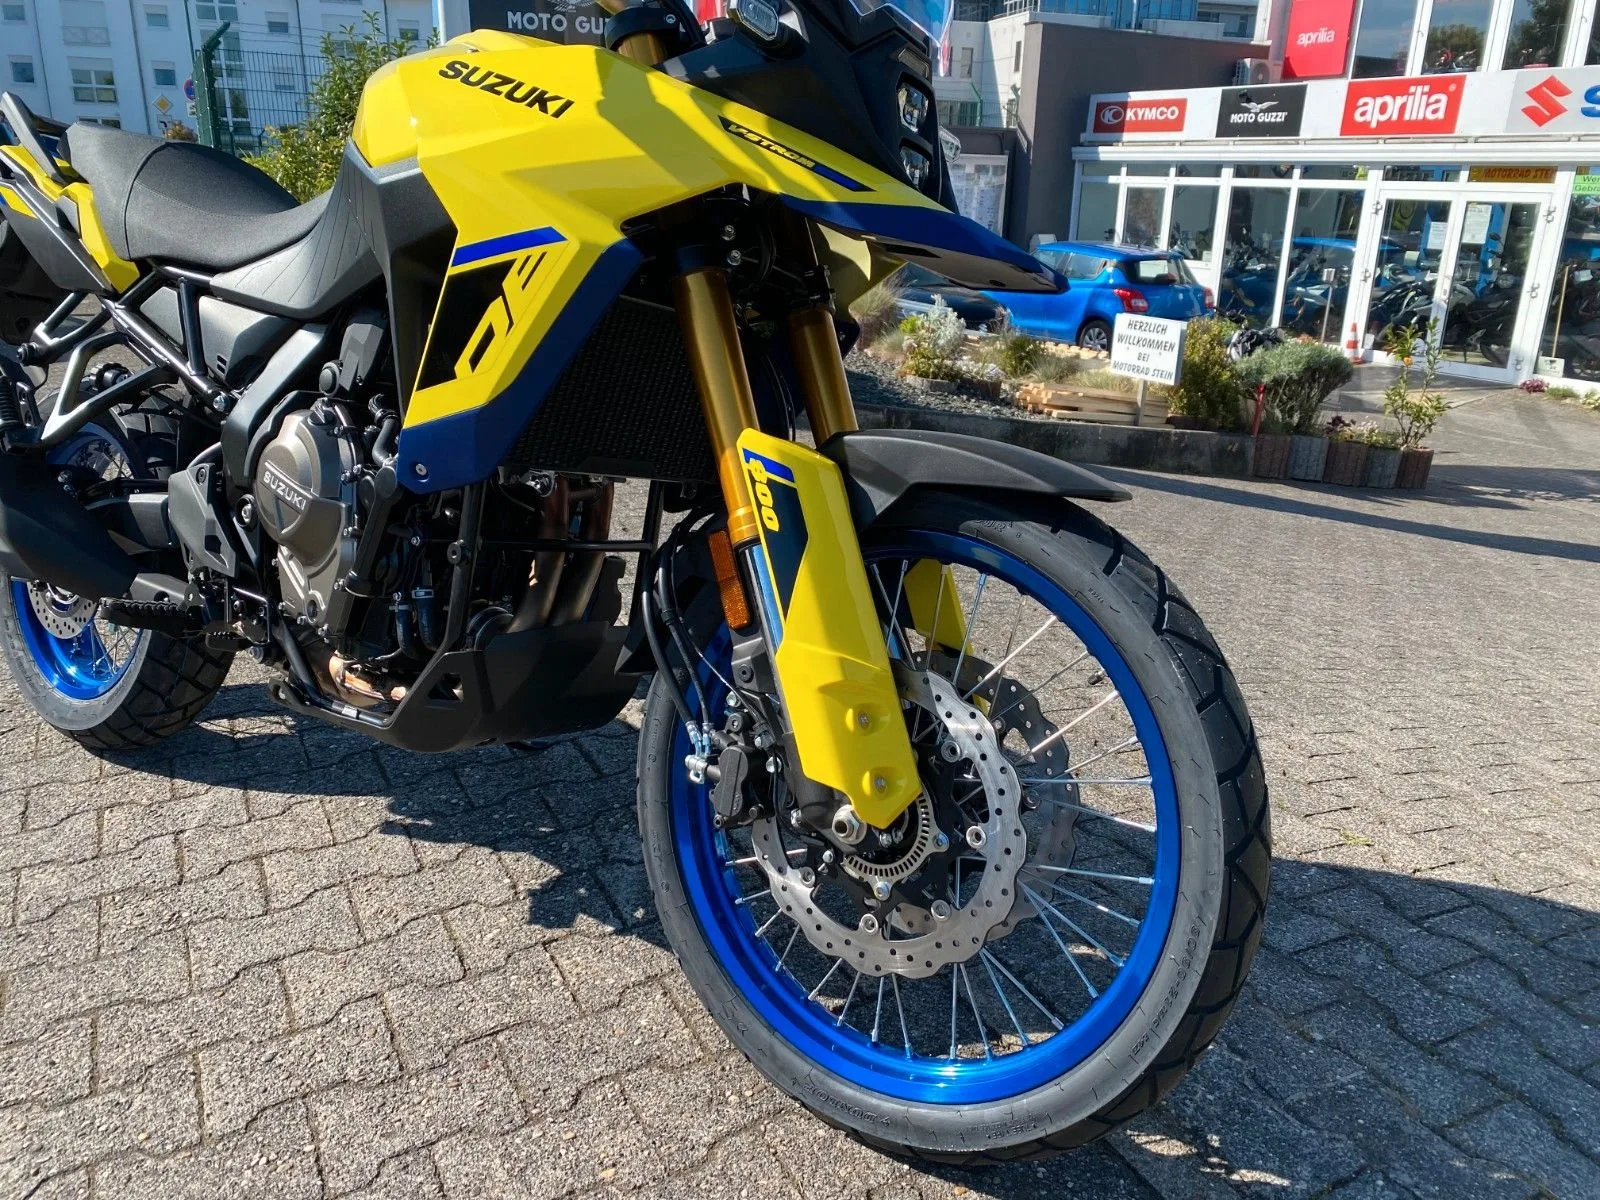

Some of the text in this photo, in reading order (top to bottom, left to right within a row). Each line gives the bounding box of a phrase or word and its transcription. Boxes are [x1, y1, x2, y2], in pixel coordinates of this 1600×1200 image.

[507, 12, 611, 35] MOTO GU
[1297, 28, 1335, 47] aprilia
[438, 60, 575, 119] SUZUKI
[1126, 106, 1179, 121] KYMCO
[1354, 85, 1448, 128] aprilia
[1230, 113, 1255, 123] MOTO
[1128, 320, 1168, 335] HERZLICH
[1117, 333, 1176, 352] WILLKOMMEN
[1137, 352, 1150, 362] BEI
[1113, 361, 1173, 380] MOTORRAD STEIN
[263, 470, 307, 511] SUZUKI
